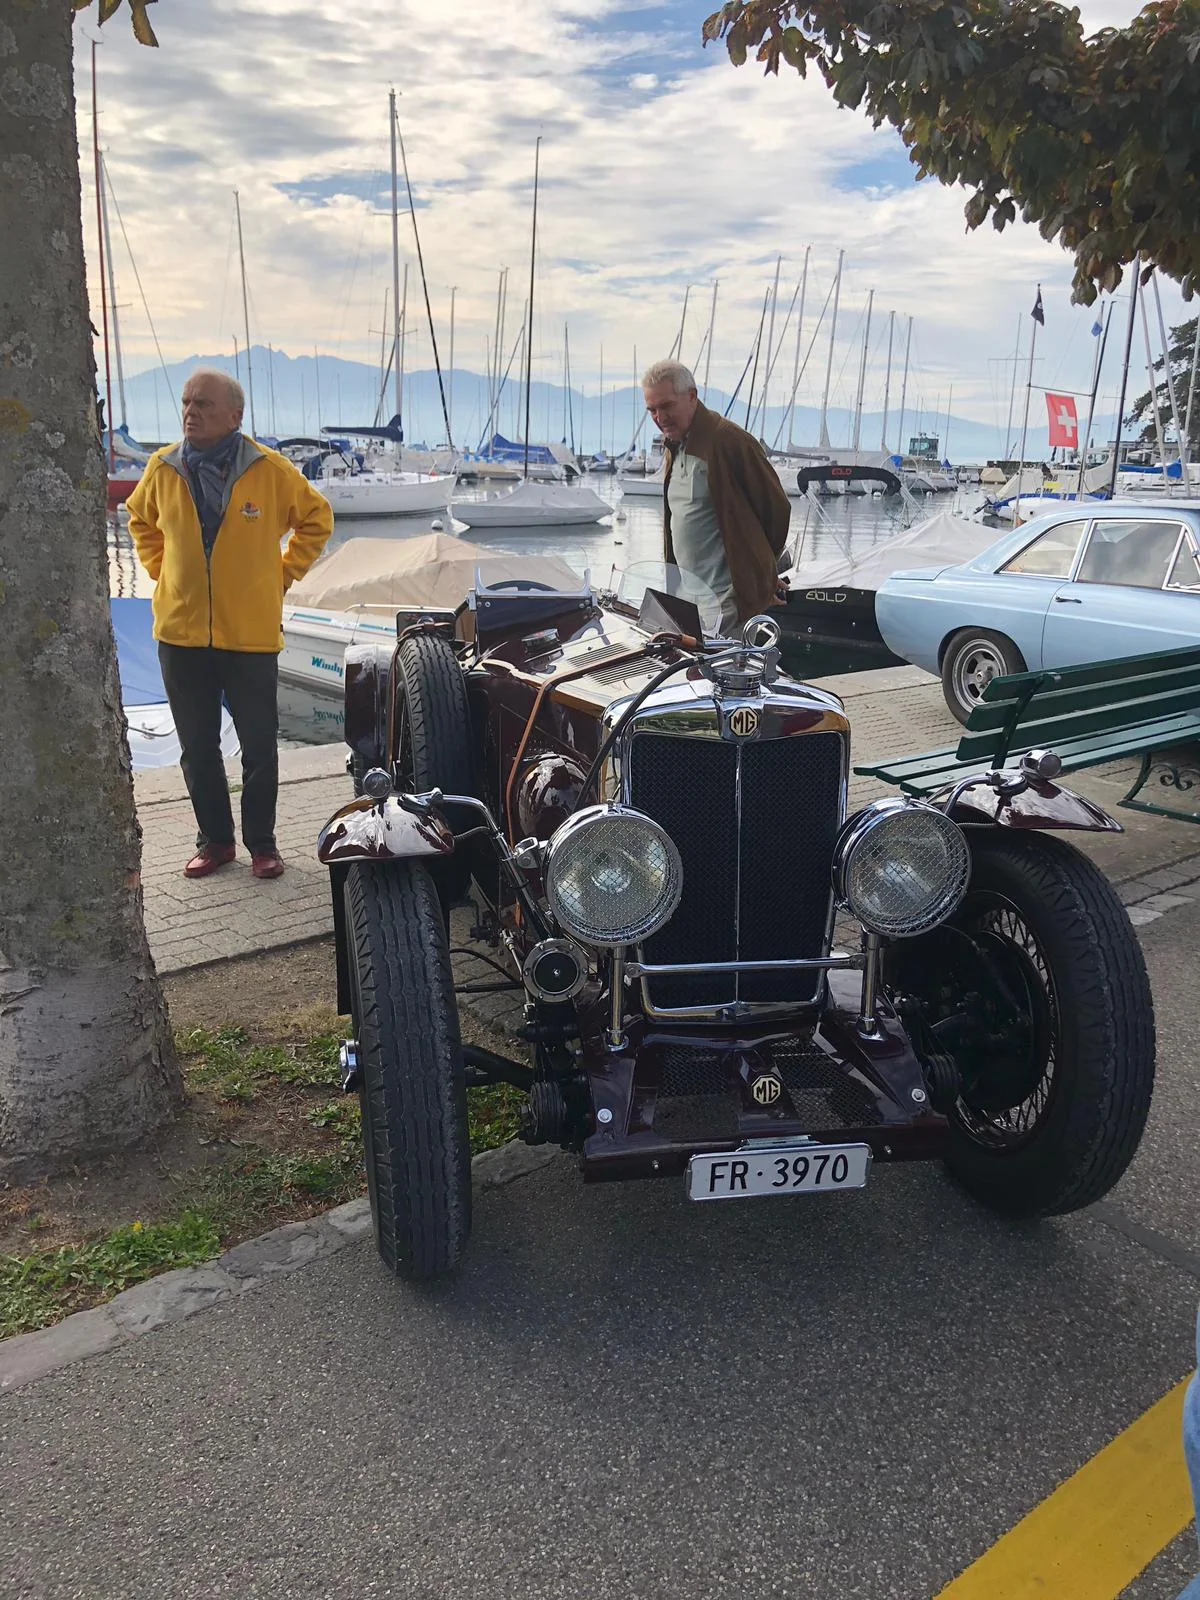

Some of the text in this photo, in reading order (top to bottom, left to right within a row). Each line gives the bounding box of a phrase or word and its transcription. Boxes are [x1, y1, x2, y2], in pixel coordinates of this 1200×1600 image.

[311, 655, 344, 677] Windy
[733, 710, 756, 734] MG
[756, 1080, 779, 1103] MG
